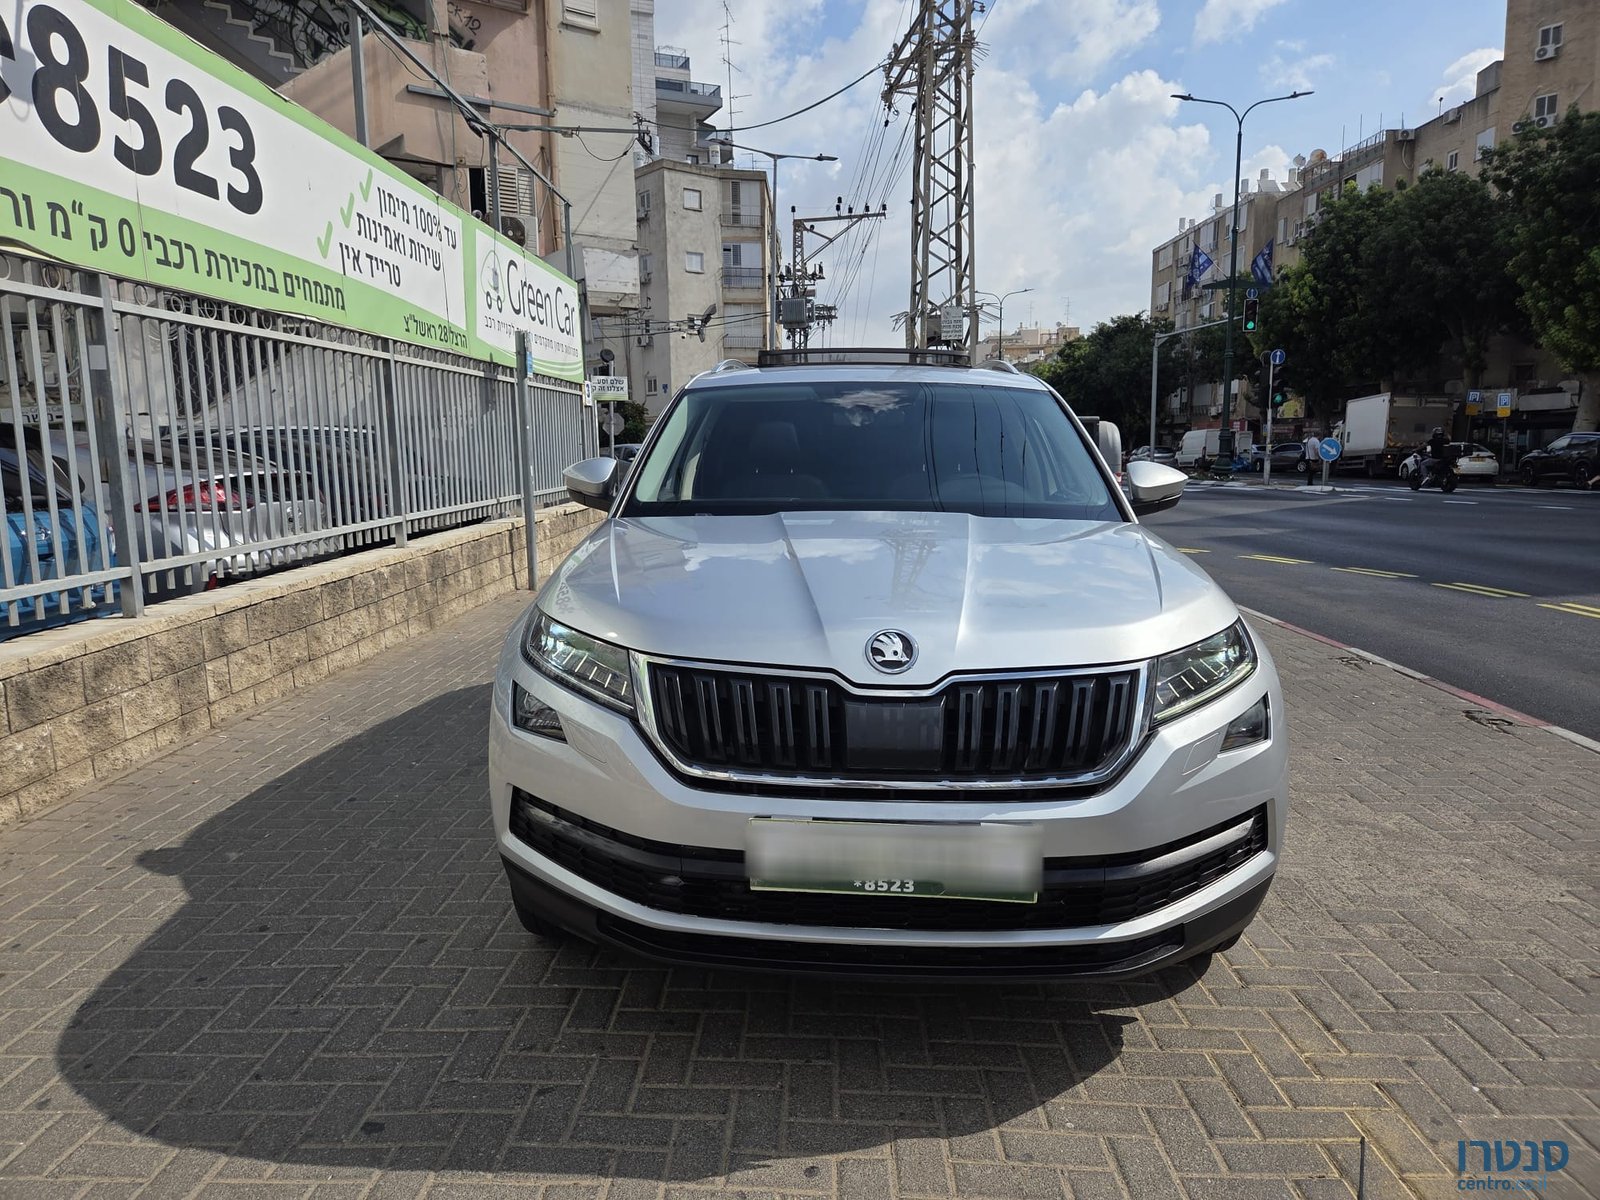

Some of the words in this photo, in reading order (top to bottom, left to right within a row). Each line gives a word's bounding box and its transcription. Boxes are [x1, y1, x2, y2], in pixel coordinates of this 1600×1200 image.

[377, 186, 410, 225] מימון
[413, 204, 442, 242] 100%
[118, 217, 136, 257] 0
[143, 231, 200, 274] רכבי
[356, 212, 406, 256] ואמינות
[444, 226, 457, 250] עד
[204, 249, 279, 294] במכירת
[339, 242, 363, 276] אין
[365, 253, 401, 287] טרייד
[409, 238, 441, 271] שירות
[283, 271, 346, 311] מתמחים
[507, 259, 554, 329] Green
[555, 286, 575, 338] Car
[437, 323, 449, 344] 28
[449, 326, 468, 349] הרצל
[484, 315, 496, 330] רכב
